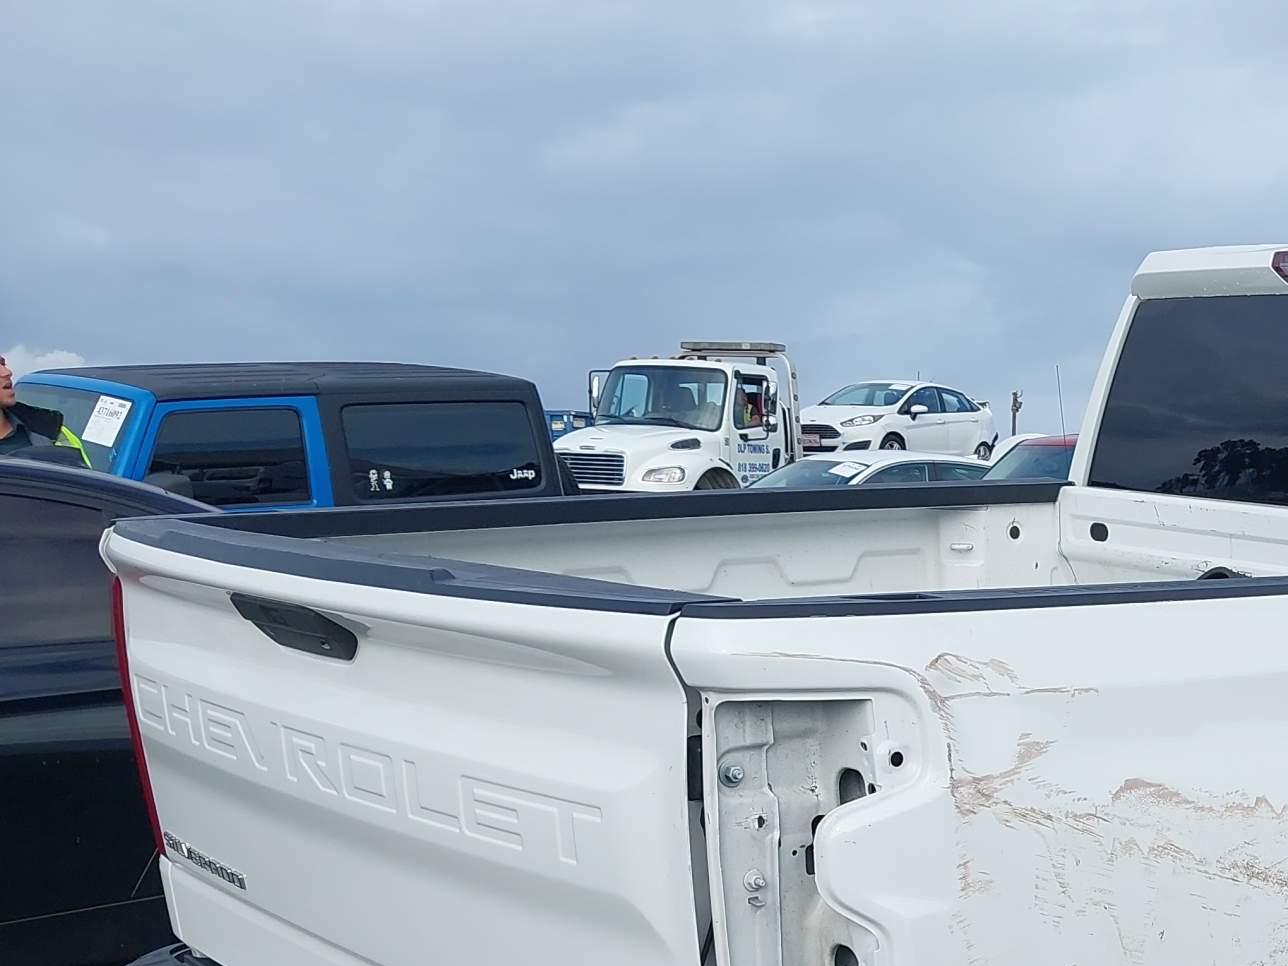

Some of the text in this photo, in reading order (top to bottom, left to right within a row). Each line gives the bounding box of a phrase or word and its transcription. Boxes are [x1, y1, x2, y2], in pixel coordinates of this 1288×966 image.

[747, 443, 765, 455] TOWING
[133, 672, 603, 866] CHEVROLET
[163, 830, 247, 891] SILVERADO
